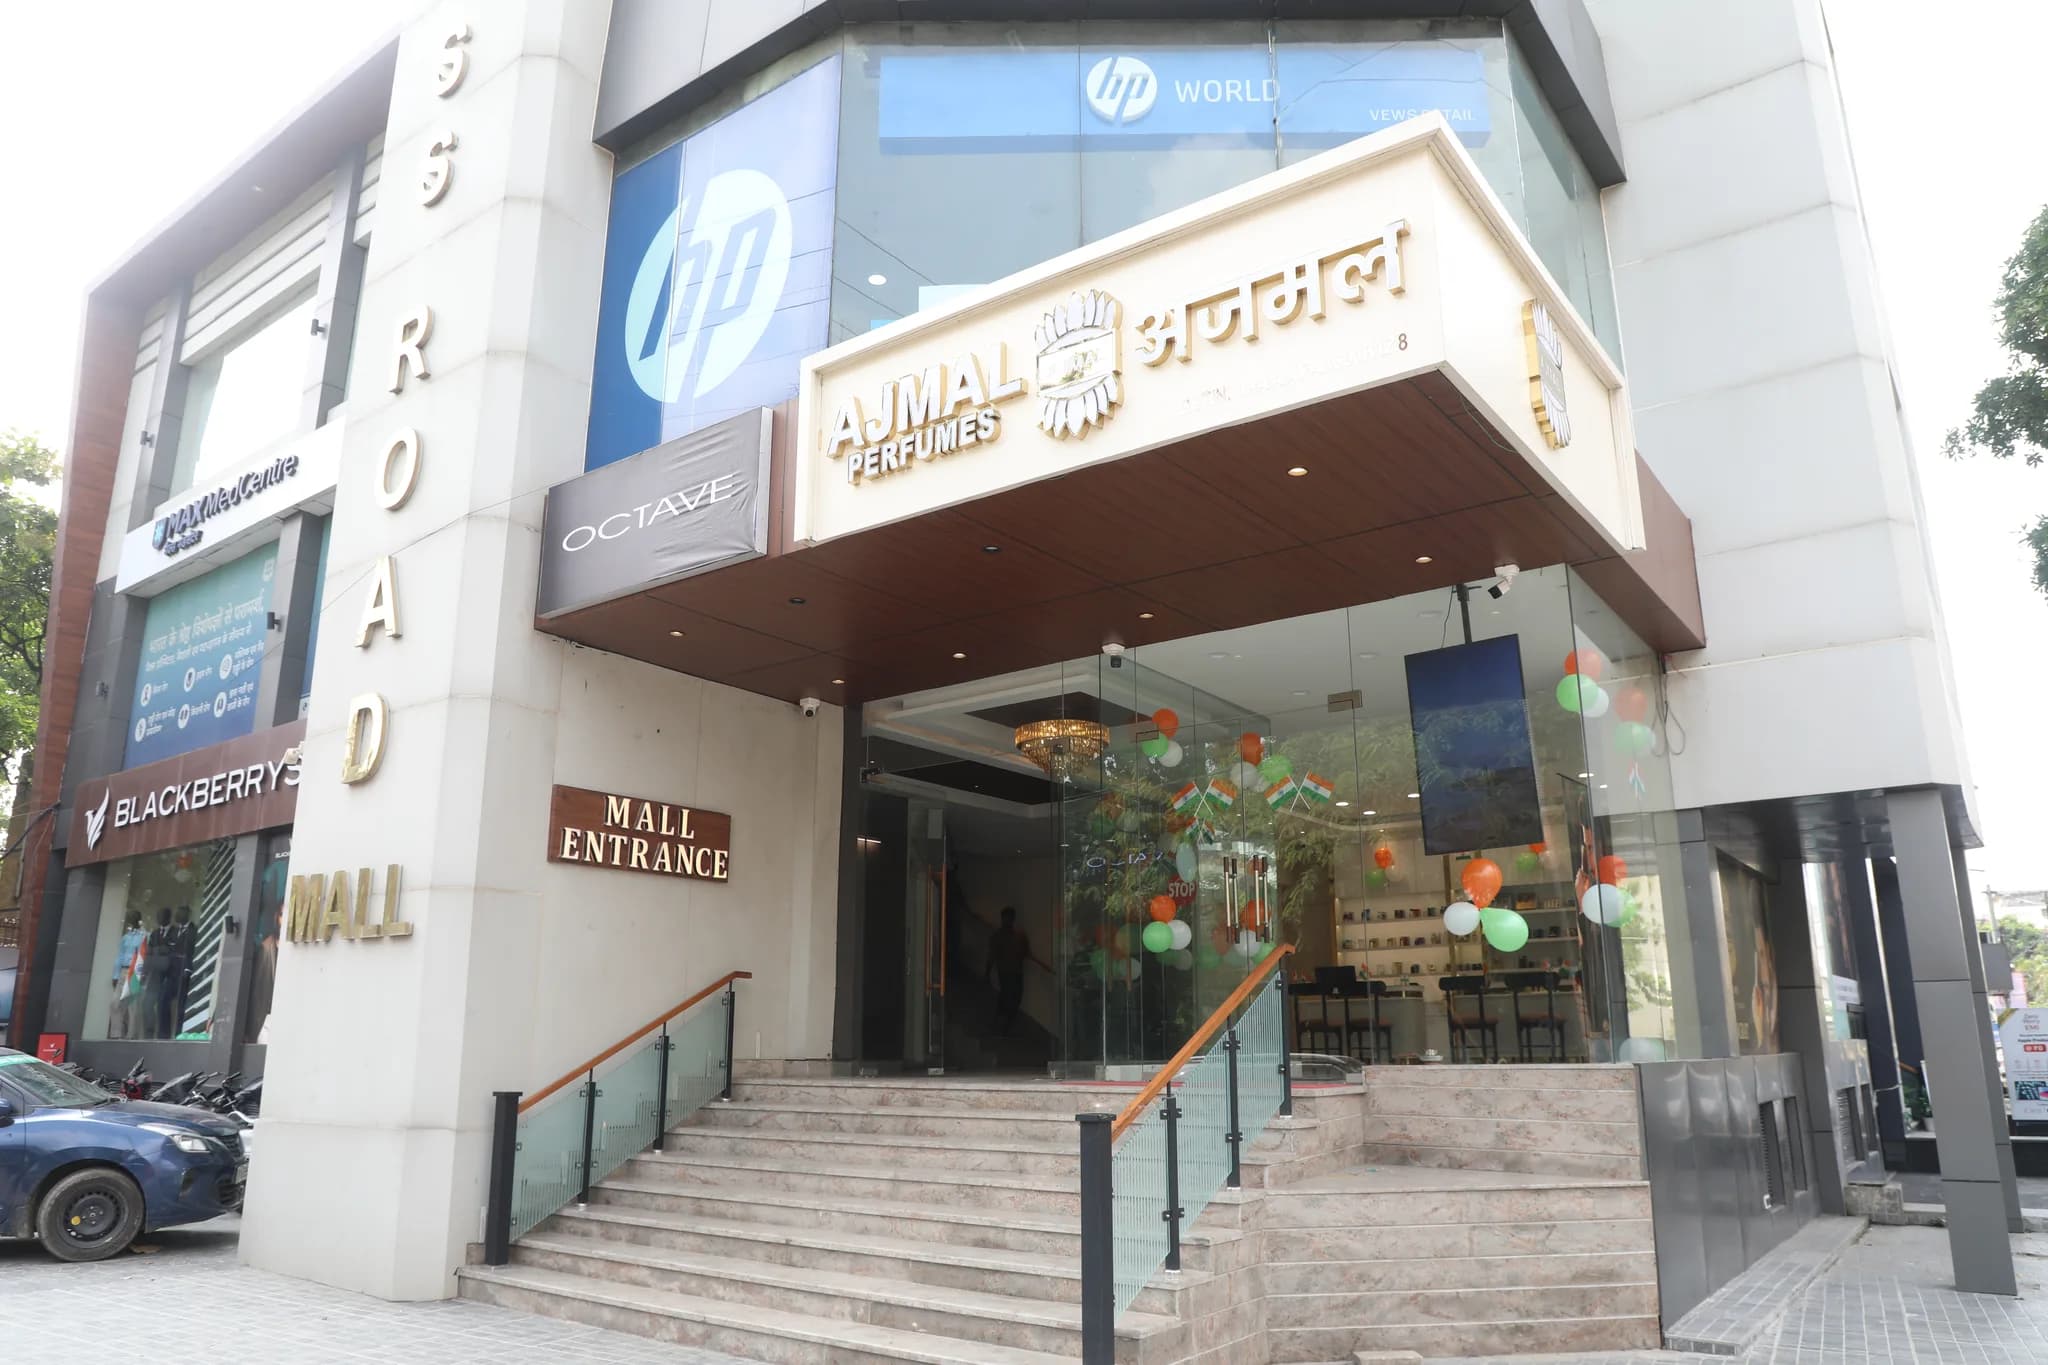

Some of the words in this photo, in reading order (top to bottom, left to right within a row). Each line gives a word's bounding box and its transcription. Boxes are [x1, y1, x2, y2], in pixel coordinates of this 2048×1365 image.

[1087, 56, 1158, 125] hp
[1174, 79, 1281, 103] WORLD
[1368, 107, 1417, 121] VEWS
[1421, 107, 1475, 121] TAIL
[625, 169, 792, 403] hp
[1135, 218, 1411, 367] अजमल
[827, 342, 1028, 459] AJMAL
[848, 405, 1001, 486] PERFUMES
[167, 499, 207, 541] MAX
[342, 303, 434, 785] ROAD
[562, 474, 734, 551] OCTAVE
[559, 827, 729, 879] ENTRANCE
[604, 795, 696, 840] MALL
[286, 863, 415, 945] MALL
[1168, 881, 1196, 898] STOP
